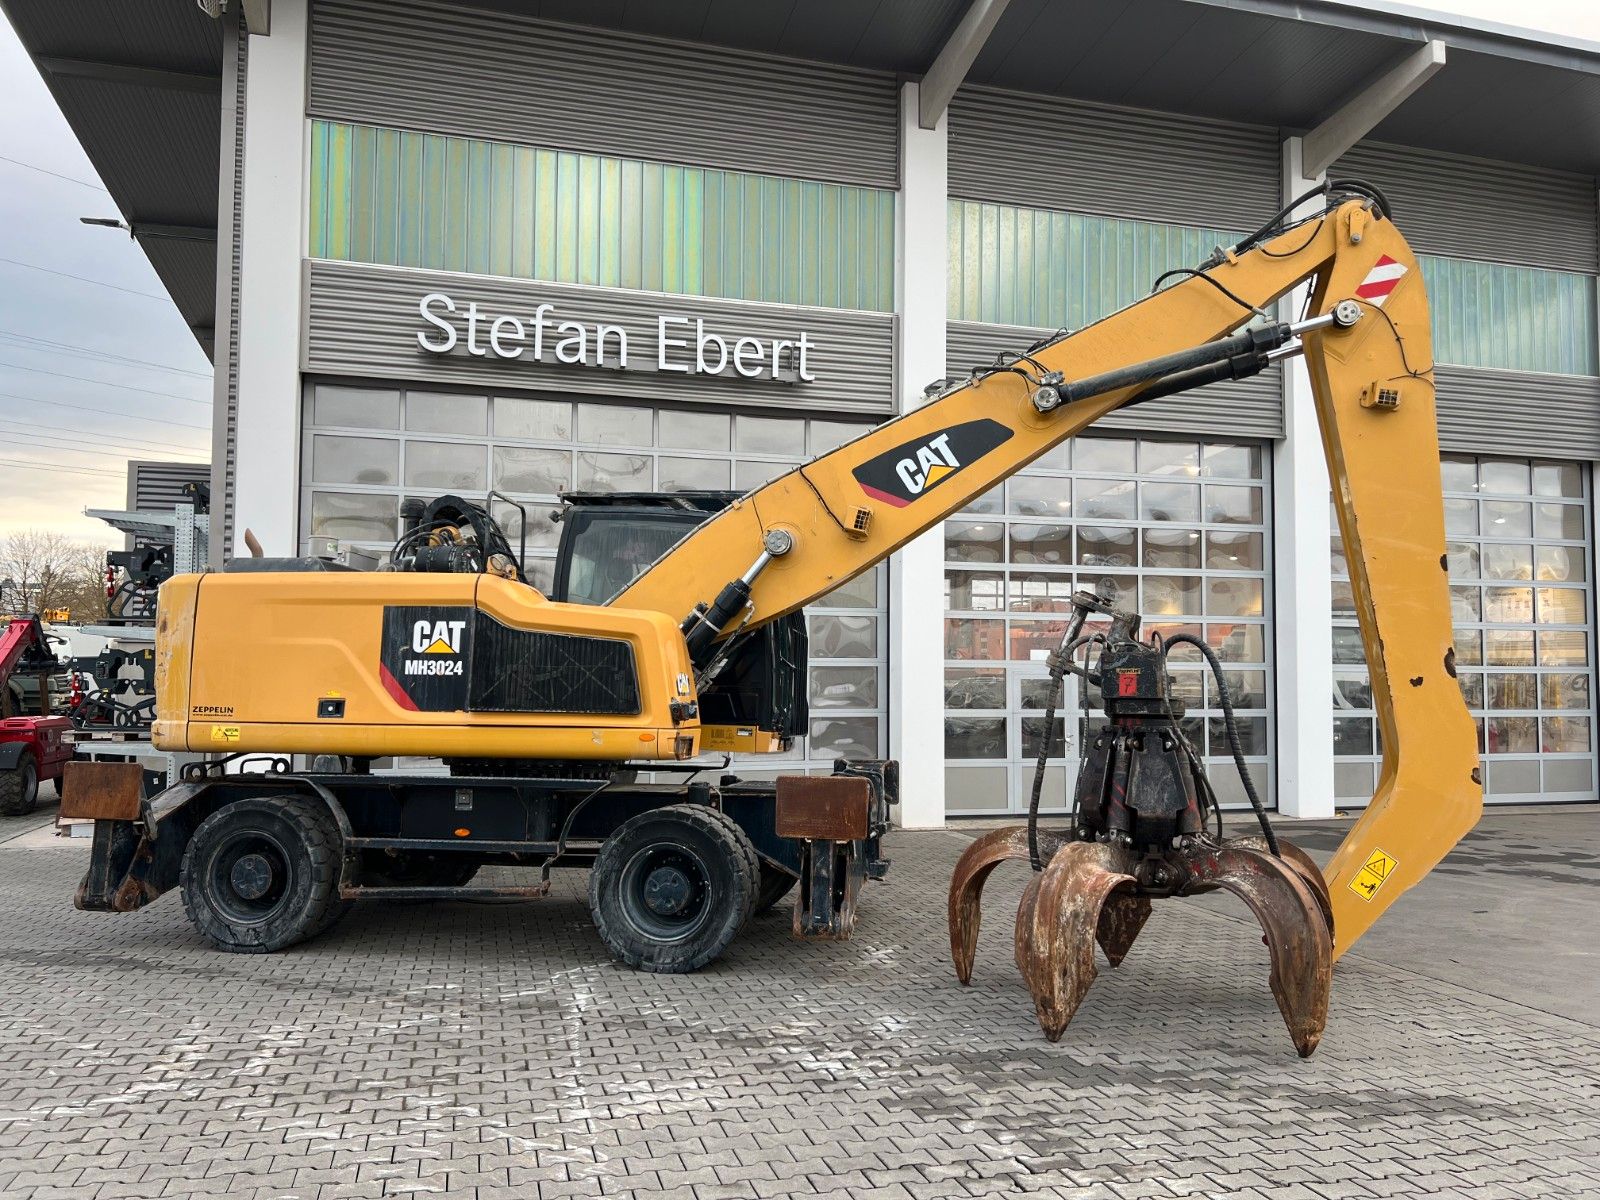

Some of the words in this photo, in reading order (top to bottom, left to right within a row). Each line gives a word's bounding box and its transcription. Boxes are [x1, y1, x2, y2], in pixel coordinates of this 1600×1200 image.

[417, 293, 629, 367] Stefan
[657, 315, 816, 382] Ebert
[895, 432, 961, 494] CAT
[413, 620, 466, 654] CAT
[404, 659, 463, 676] MH3024
